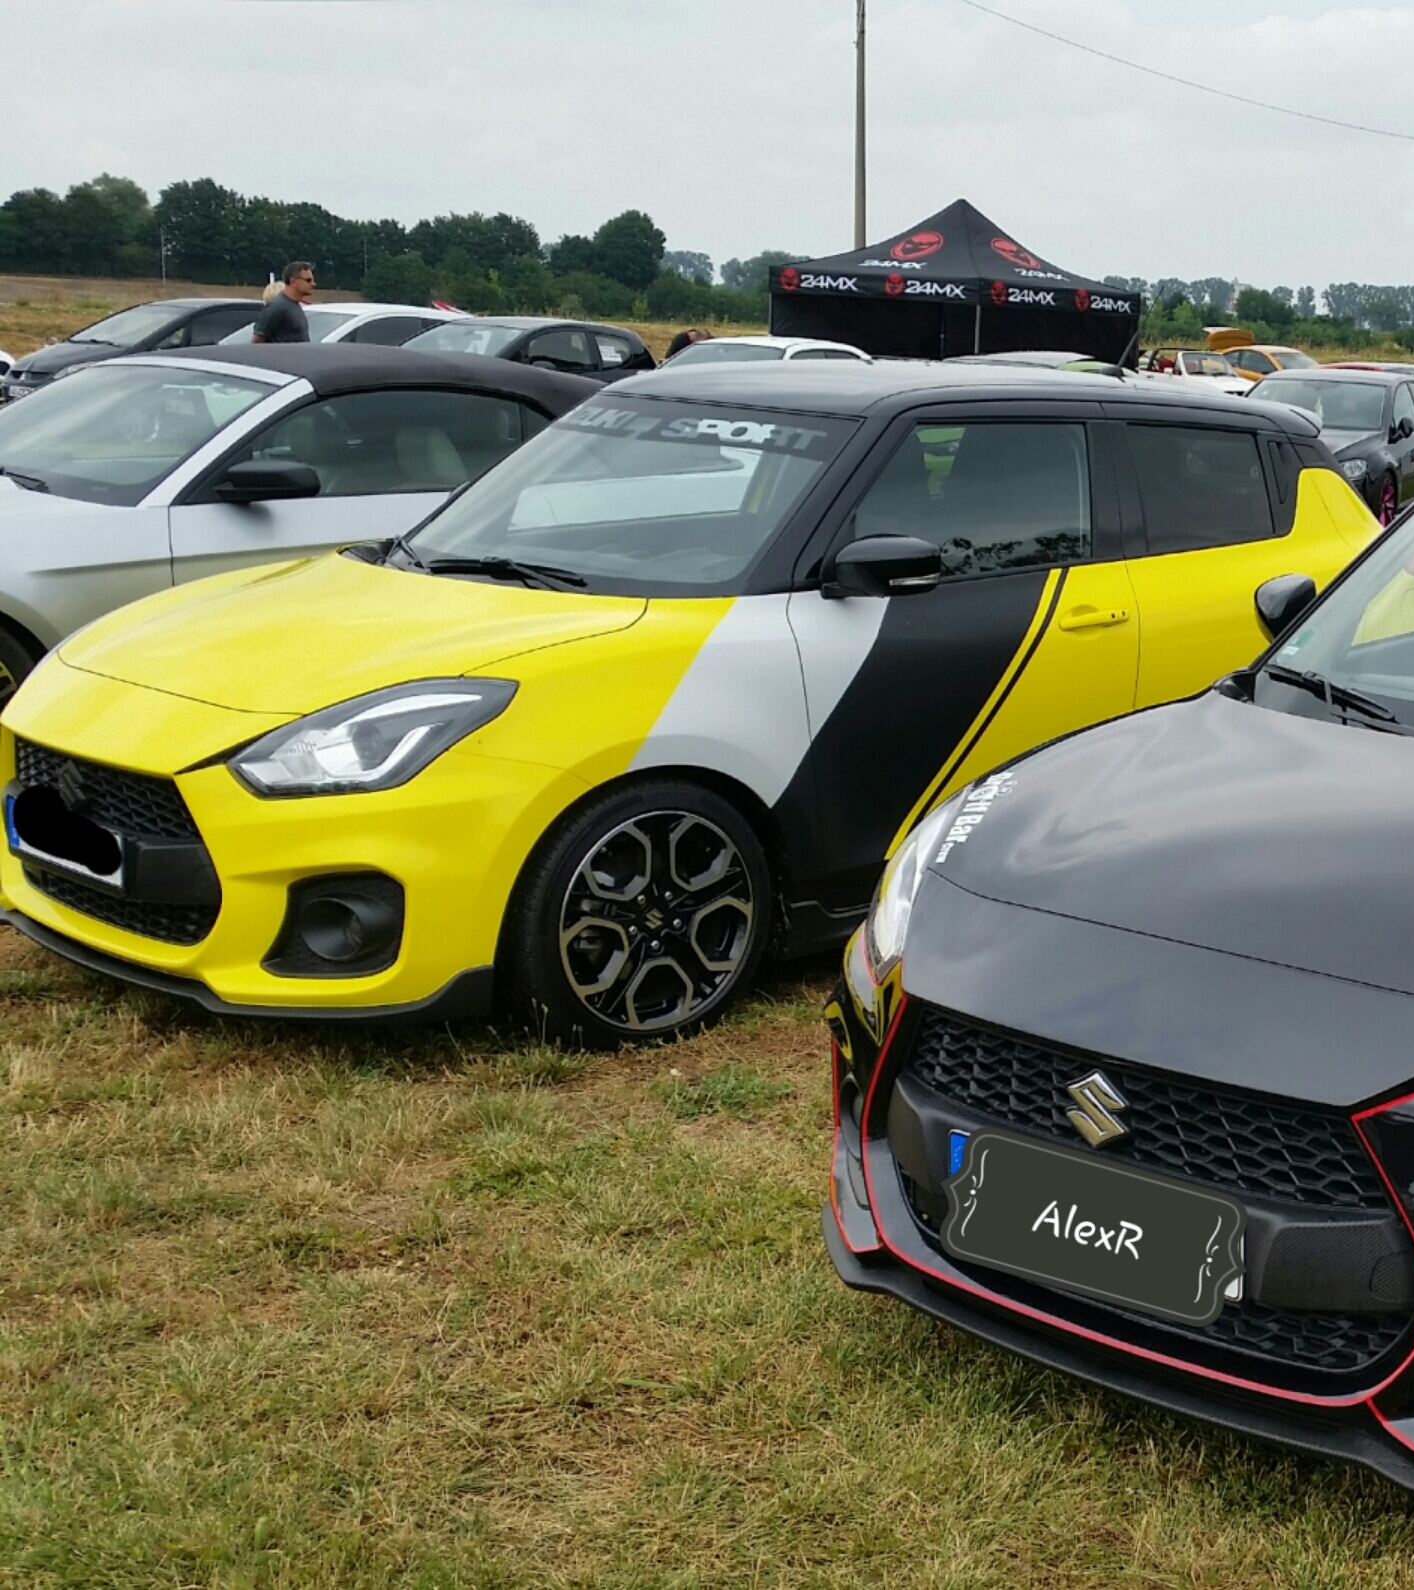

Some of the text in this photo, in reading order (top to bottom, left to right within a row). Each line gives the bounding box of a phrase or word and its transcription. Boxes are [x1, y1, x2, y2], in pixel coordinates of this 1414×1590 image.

[800, 274, 858, 291] 24MX
[904, 279, 966, 299] 24MX
[1007, 287, 1056, 306] 24MX
[1090, 295, 1132, 314] 24MX
[660, 416, 827, 450] SPORT
